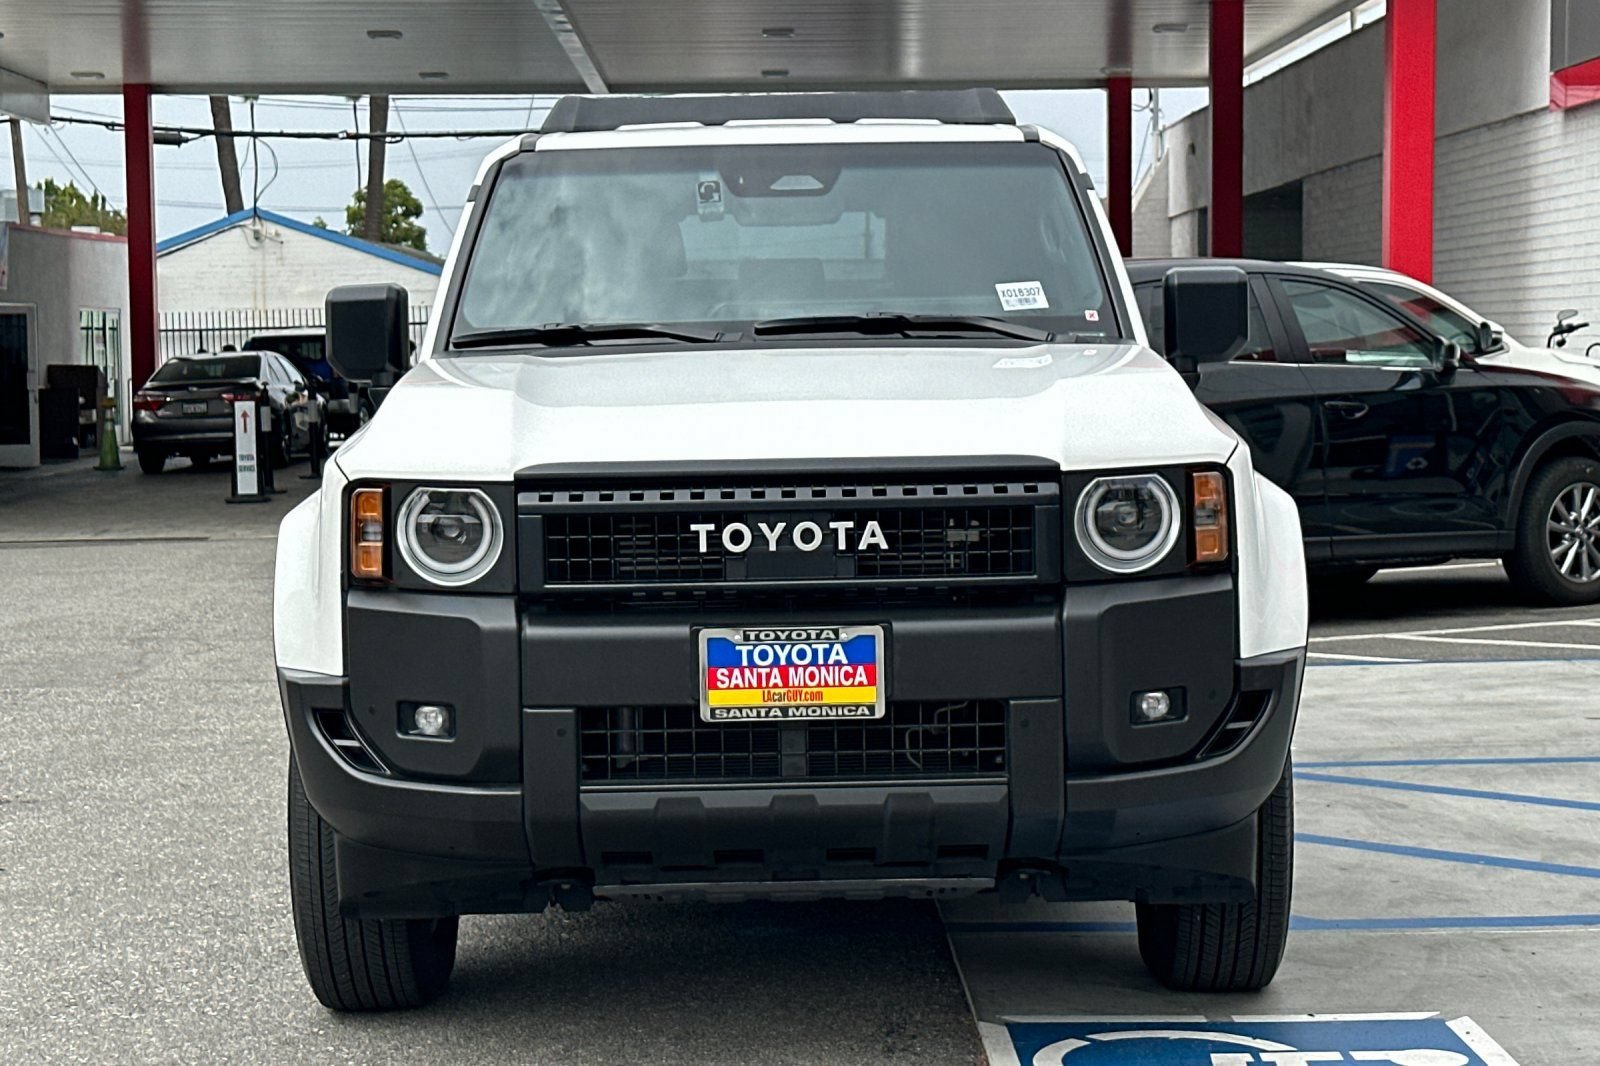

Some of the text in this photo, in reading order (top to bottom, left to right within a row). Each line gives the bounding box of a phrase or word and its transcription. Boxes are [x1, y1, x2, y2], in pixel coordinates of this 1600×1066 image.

[1001, 287, 1040, 298] X018307
[690, 521, 889, 553] TOYOTA
[745, 629, 837, 641] TOYOTA
[735, 643, 848, 667] TOYOTA
[716, 665, 868, 688] SANTA MONICA
[762, 689, 823, 703] LAcarGUY.com
[715, 705, 870, 719] SANTA MONICA
